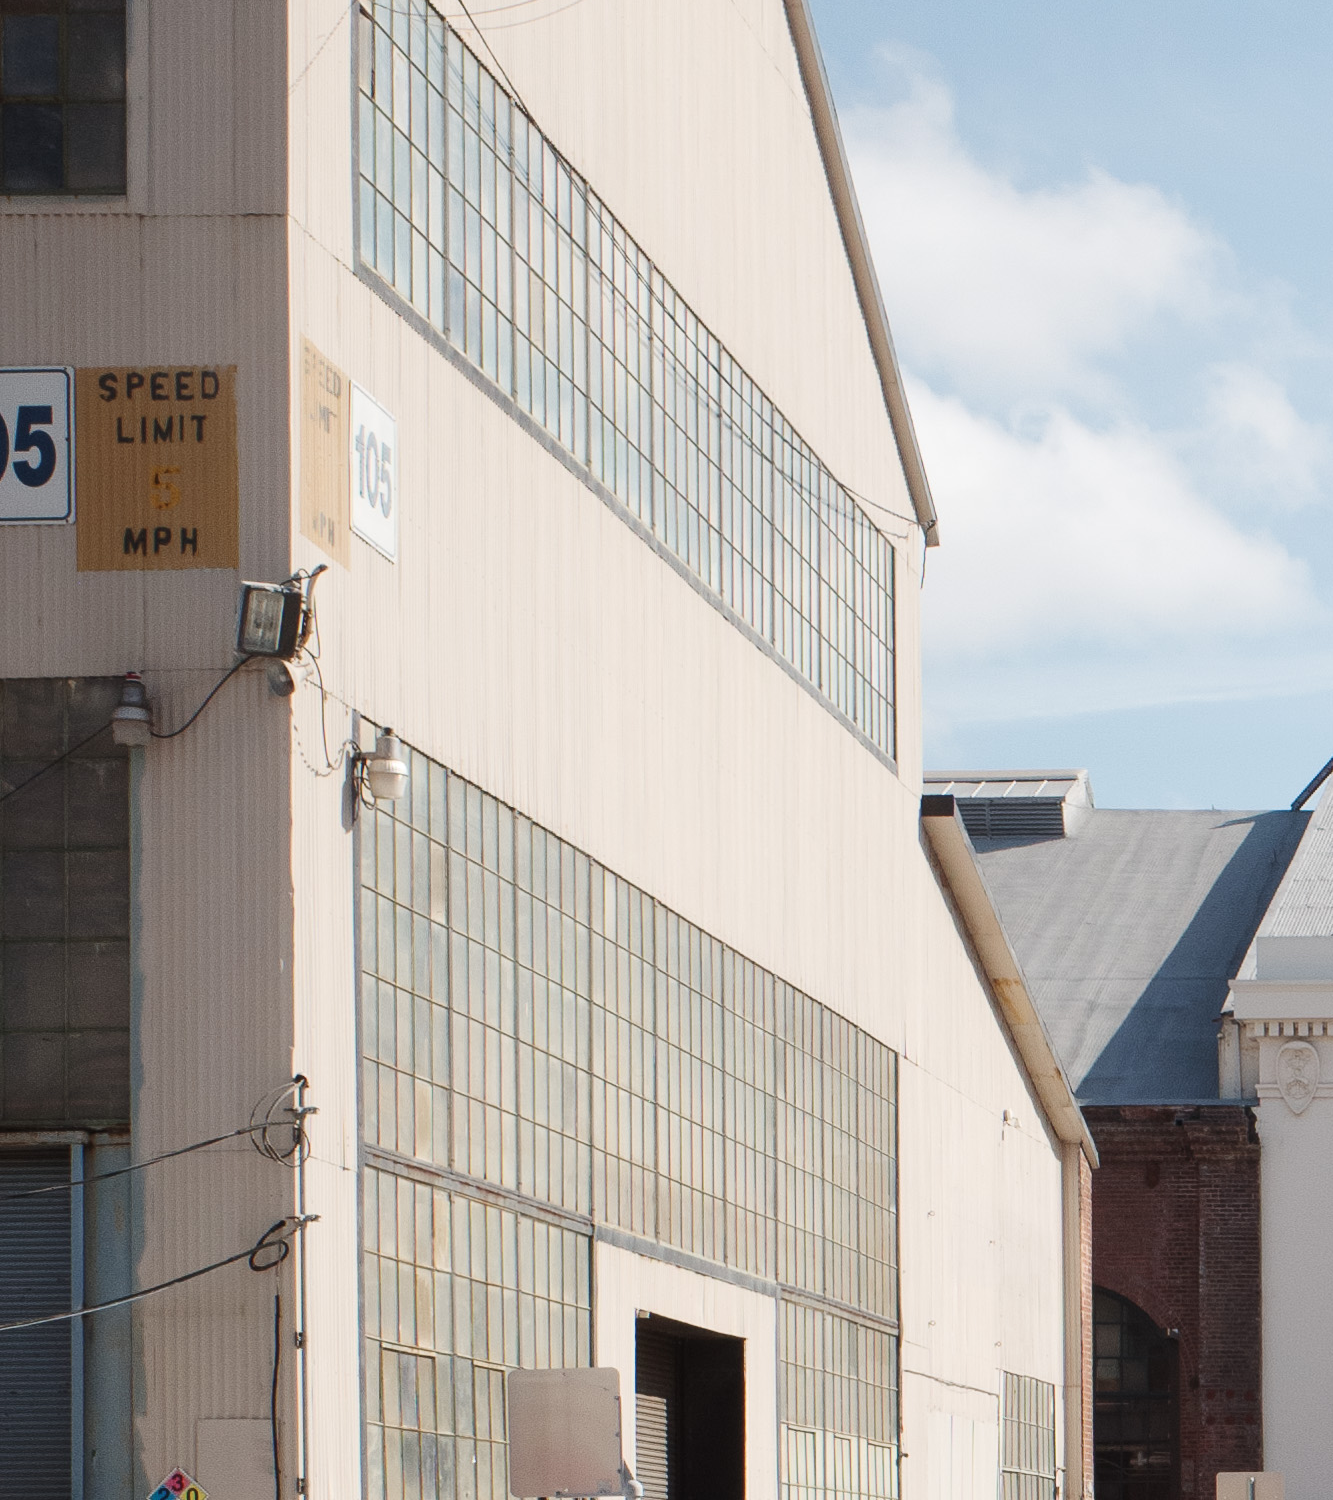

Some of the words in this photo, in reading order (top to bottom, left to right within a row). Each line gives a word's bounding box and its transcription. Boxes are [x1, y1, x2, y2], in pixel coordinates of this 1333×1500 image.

[99, 371, 220, 401] SPEED
[116, 415, 207, 444] LIMIT
[0, 405, 57, 488] 5
[356, 424, 392, 519] 105
[150, 466, 182, 511] 5
[123, 527, 198, 555] MPH
[171, 1473, 184, 1492] 3
